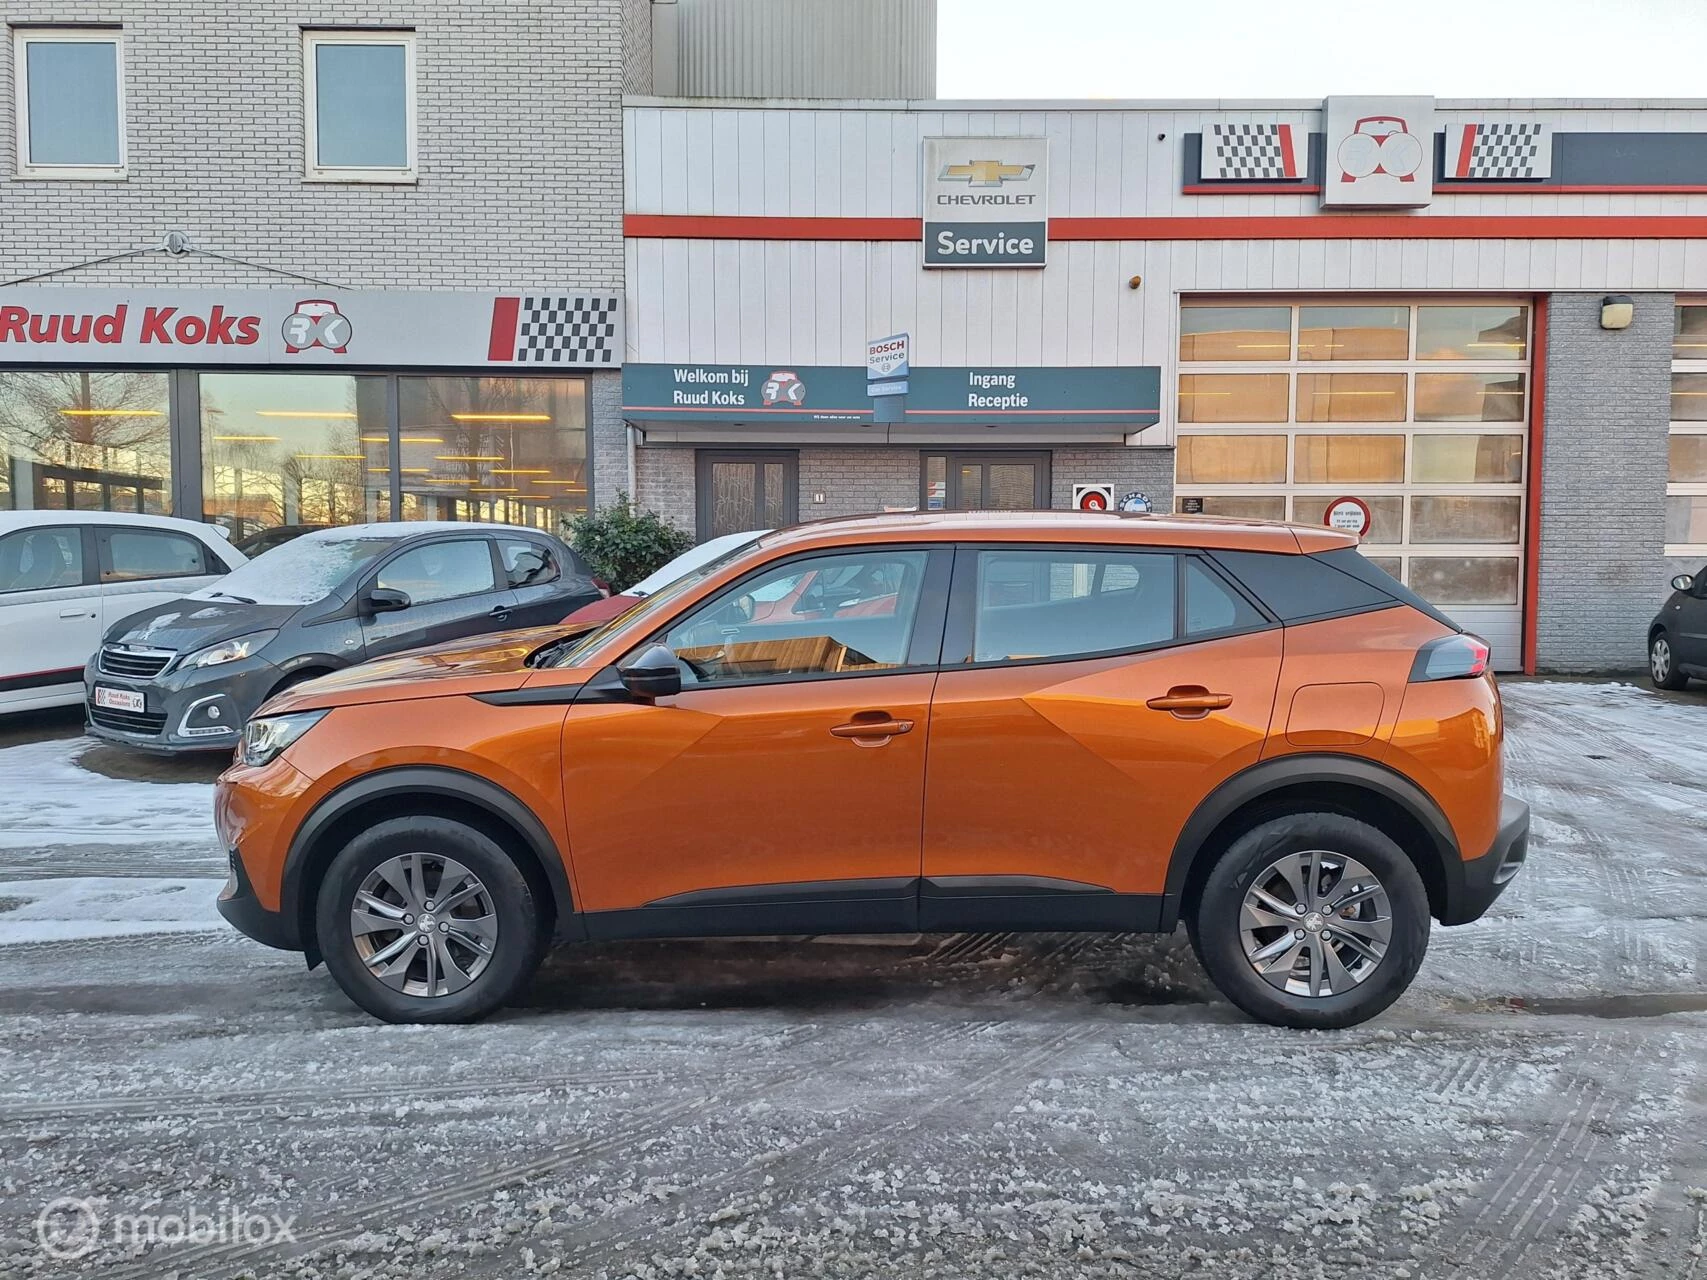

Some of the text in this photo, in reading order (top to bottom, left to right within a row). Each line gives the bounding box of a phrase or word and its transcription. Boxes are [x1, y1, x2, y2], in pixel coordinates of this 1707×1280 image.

[937, 194, 1036, 205] CHEVROLET
[937, 231, 1034, 255] Service
[0, 304, 261, 345] Ruud Koks
[869, 340, 905, 355] BOSCH
[869, 352, 905, 364] Service
[673, 368, 749, 387] Welkom bij
[969, 371, 1016, 389] Ingang
[673, 390, 745, 406] Ruud Koks
[968, 393, 1028, 410] Receptie
